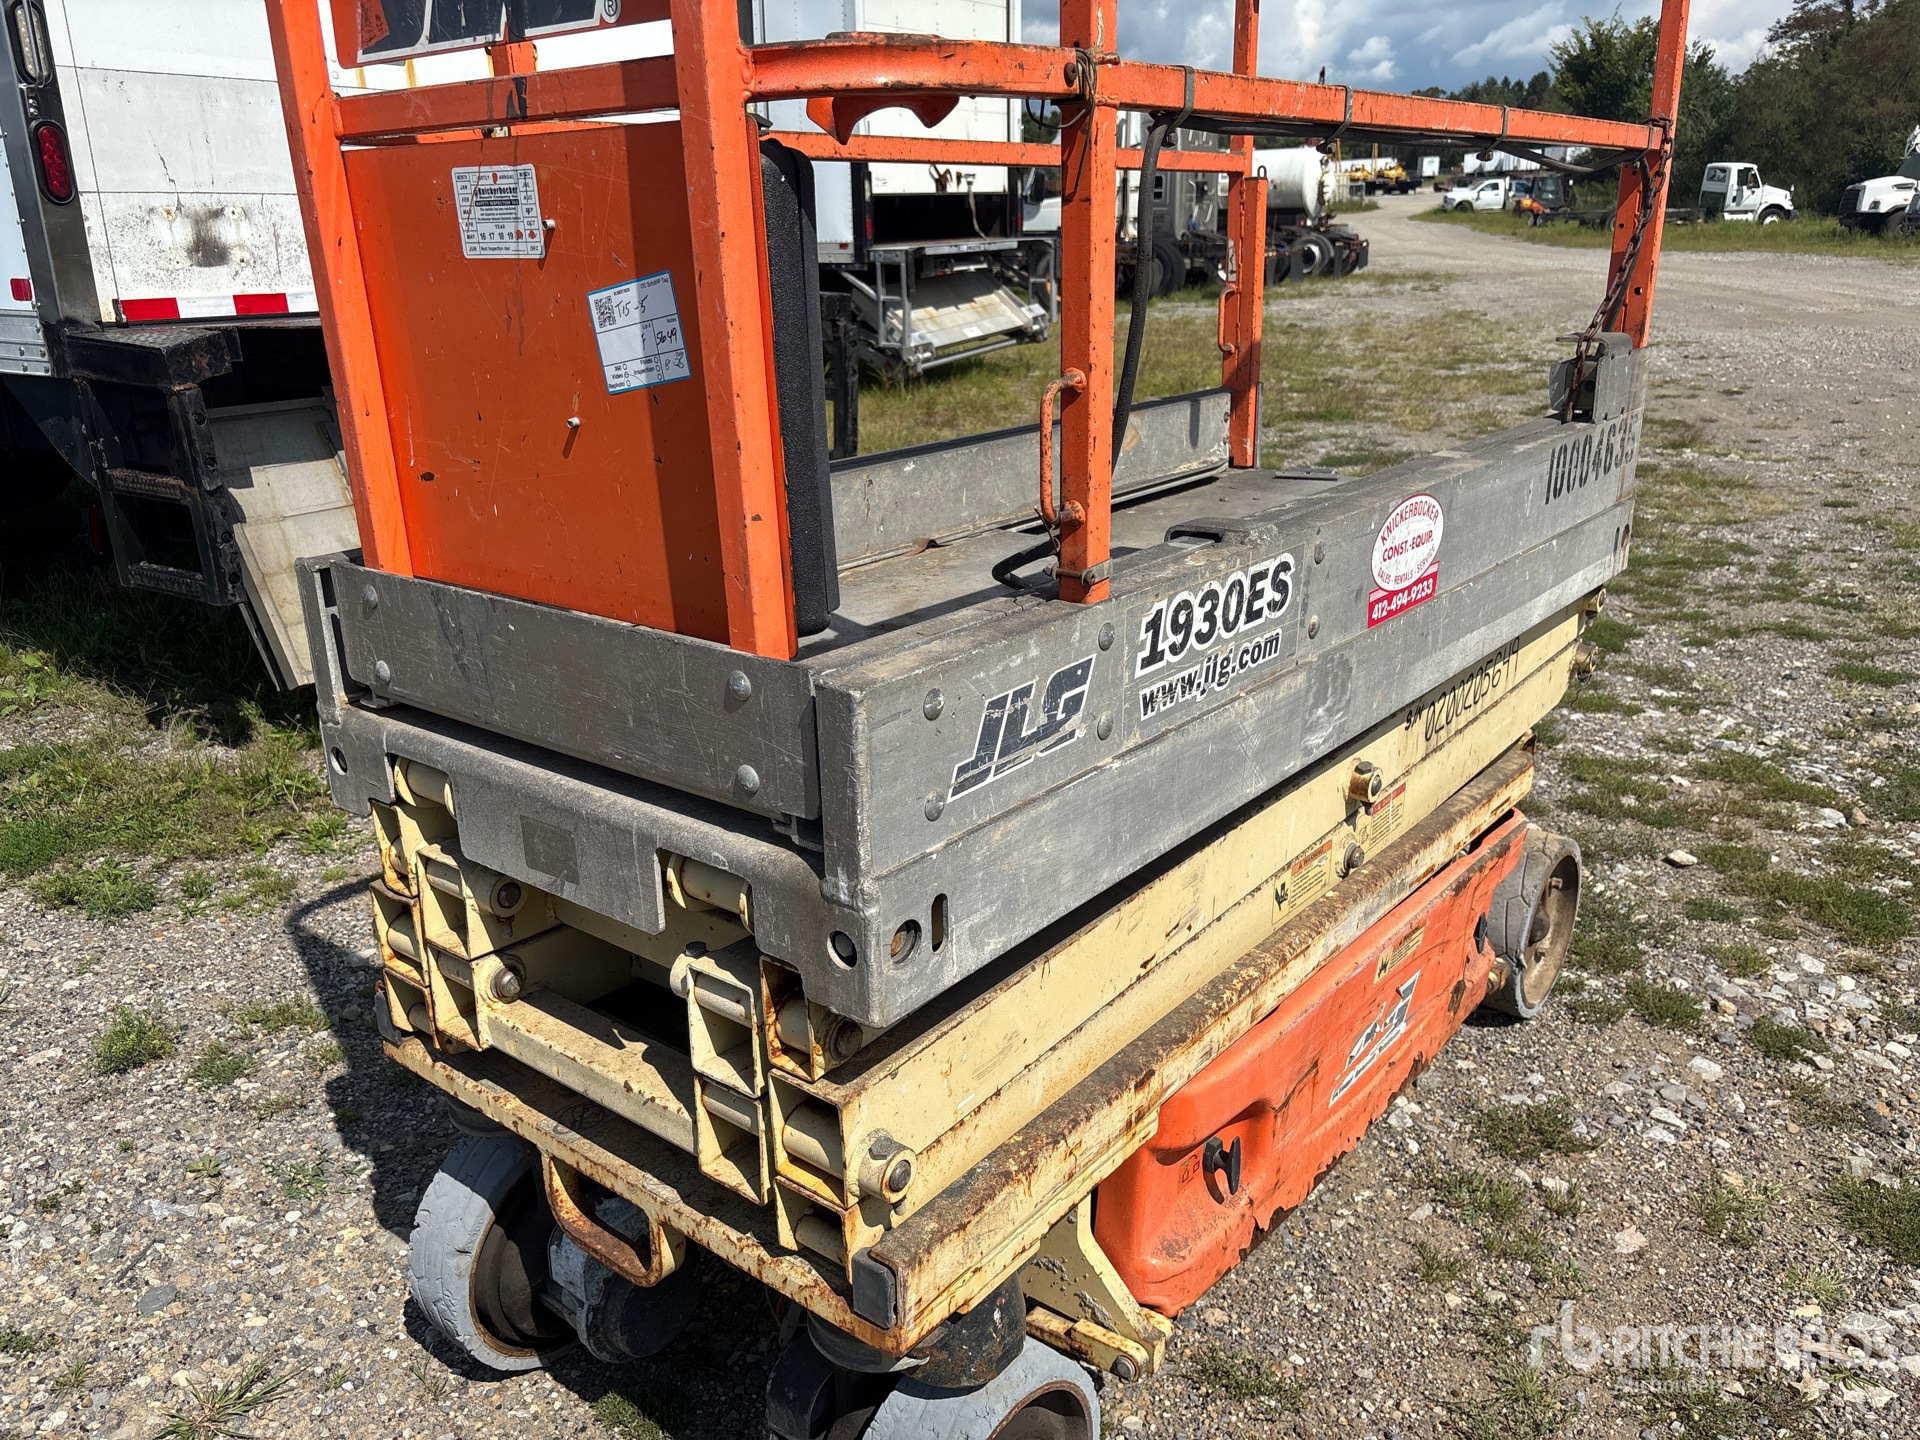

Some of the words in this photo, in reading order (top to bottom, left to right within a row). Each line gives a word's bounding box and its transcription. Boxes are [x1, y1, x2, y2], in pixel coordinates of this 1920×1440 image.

[656, 327, 678, 346] 5649
[633, 366, 655, 376] Inspection
[1380, 499, 1441, 547] KNICKERBOCKER
[1371, 577, 1434, 621] 412-494-9233
[1394, 569, 1414, 585] RENTALS
[1137, 554, 1294, 676] 1930ES
[1141, 630, 1281, 720] www.jlg.com
[947, 653, 1097, 803] JLG
